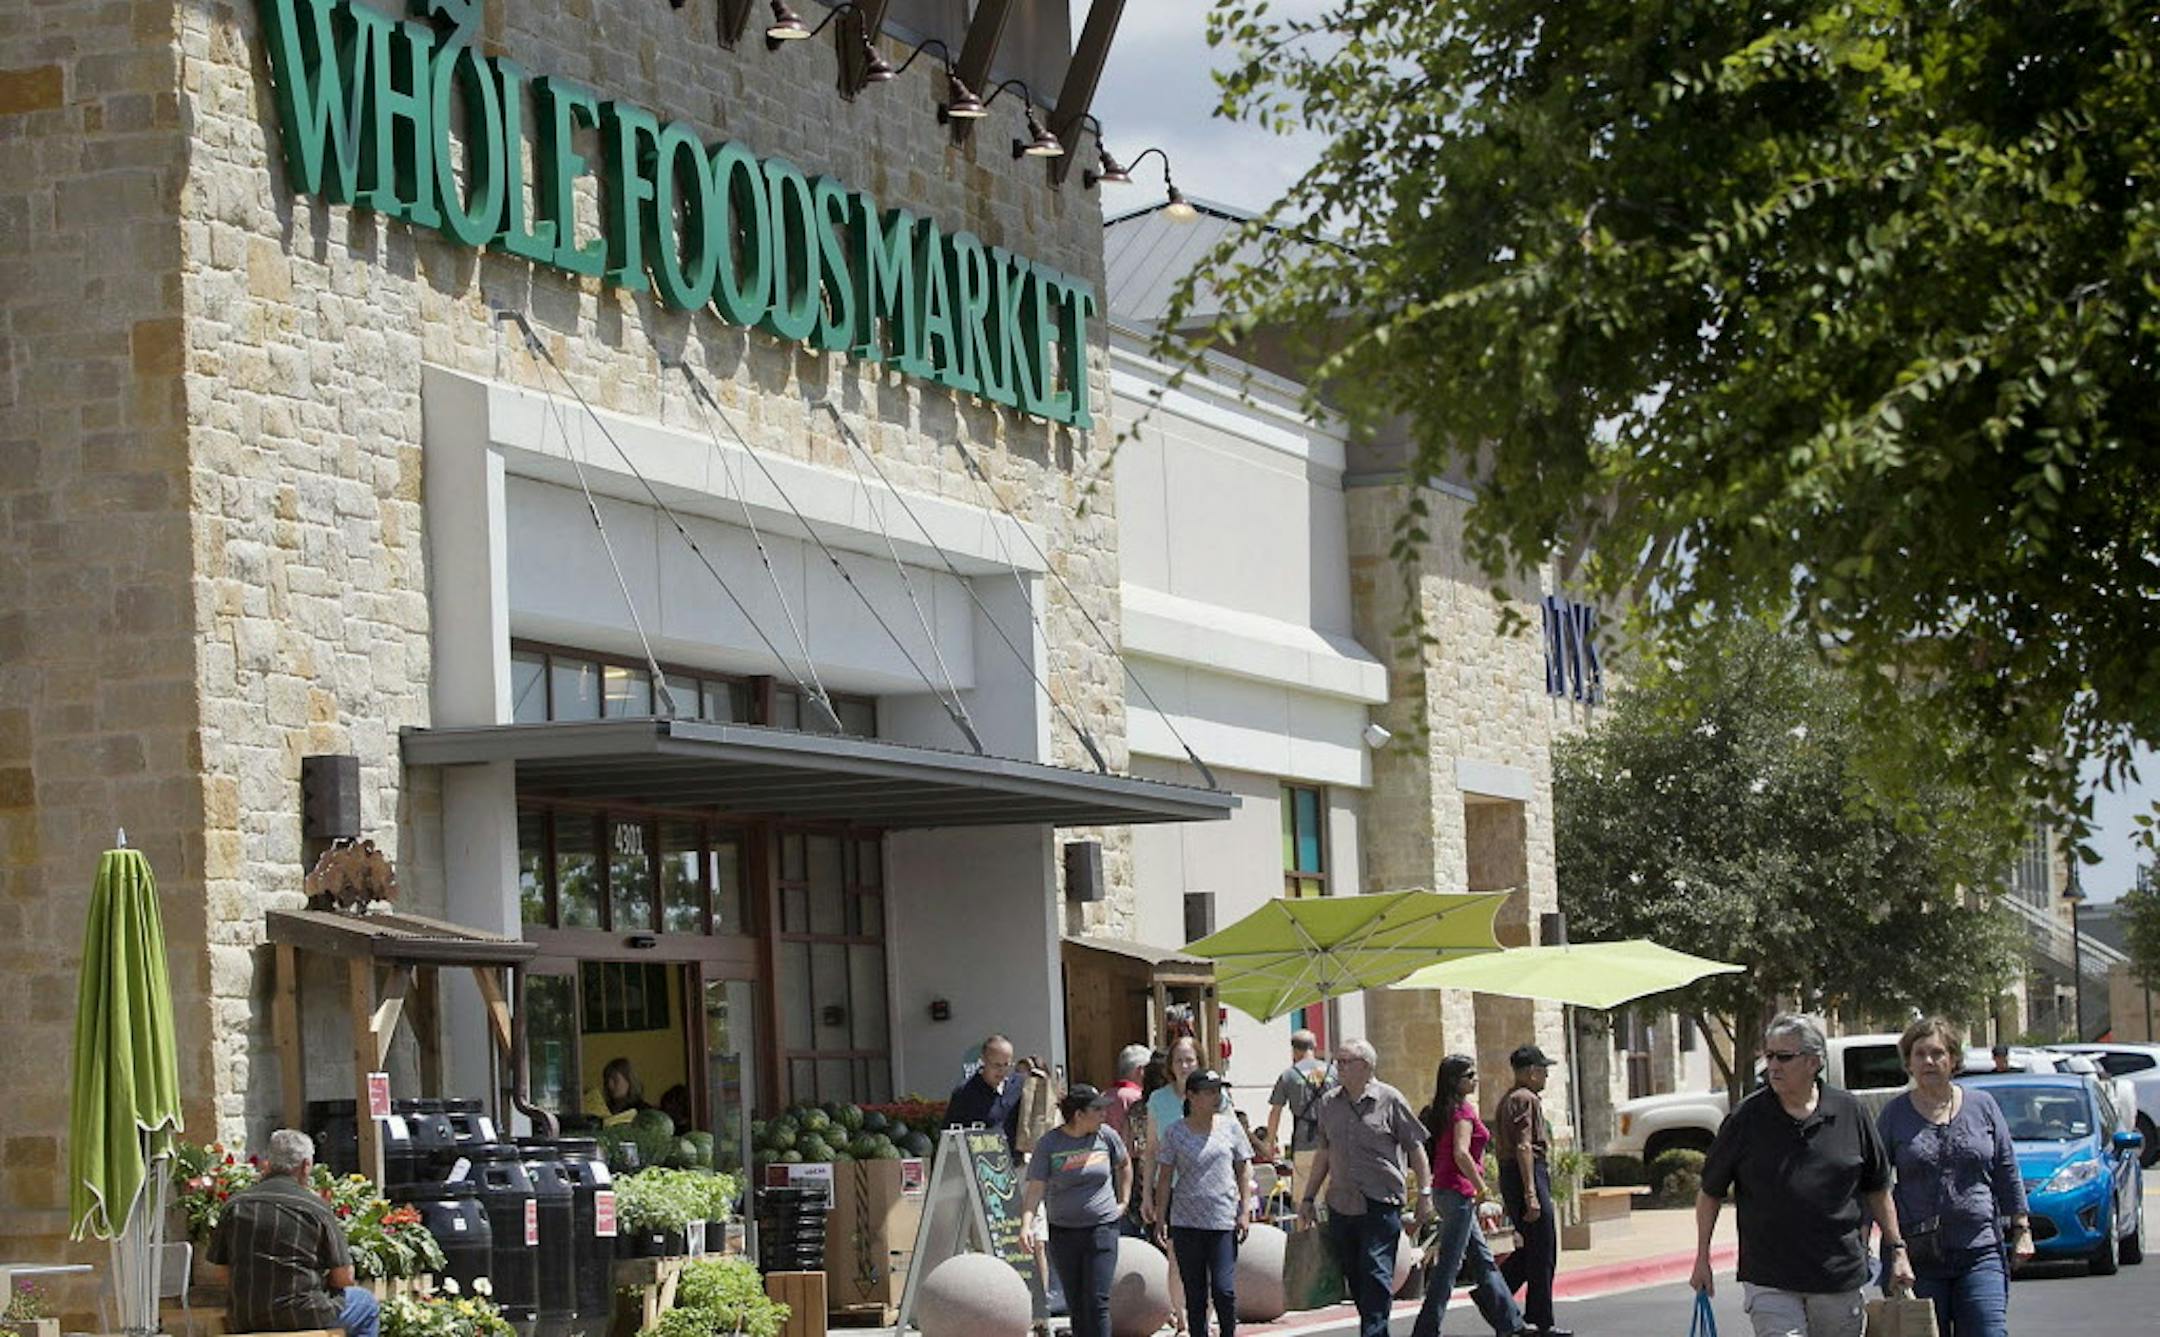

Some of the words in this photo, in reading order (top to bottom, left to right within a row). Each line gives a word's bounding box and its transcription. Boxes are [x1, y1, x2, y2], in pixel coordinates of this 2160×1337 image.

[262, 0, 608, 278] WHOLE
[606, 101, 855, 352] FOODS
[854, 191, 1097, 431] MARKET
[614, 823, 644, 855] 4301
